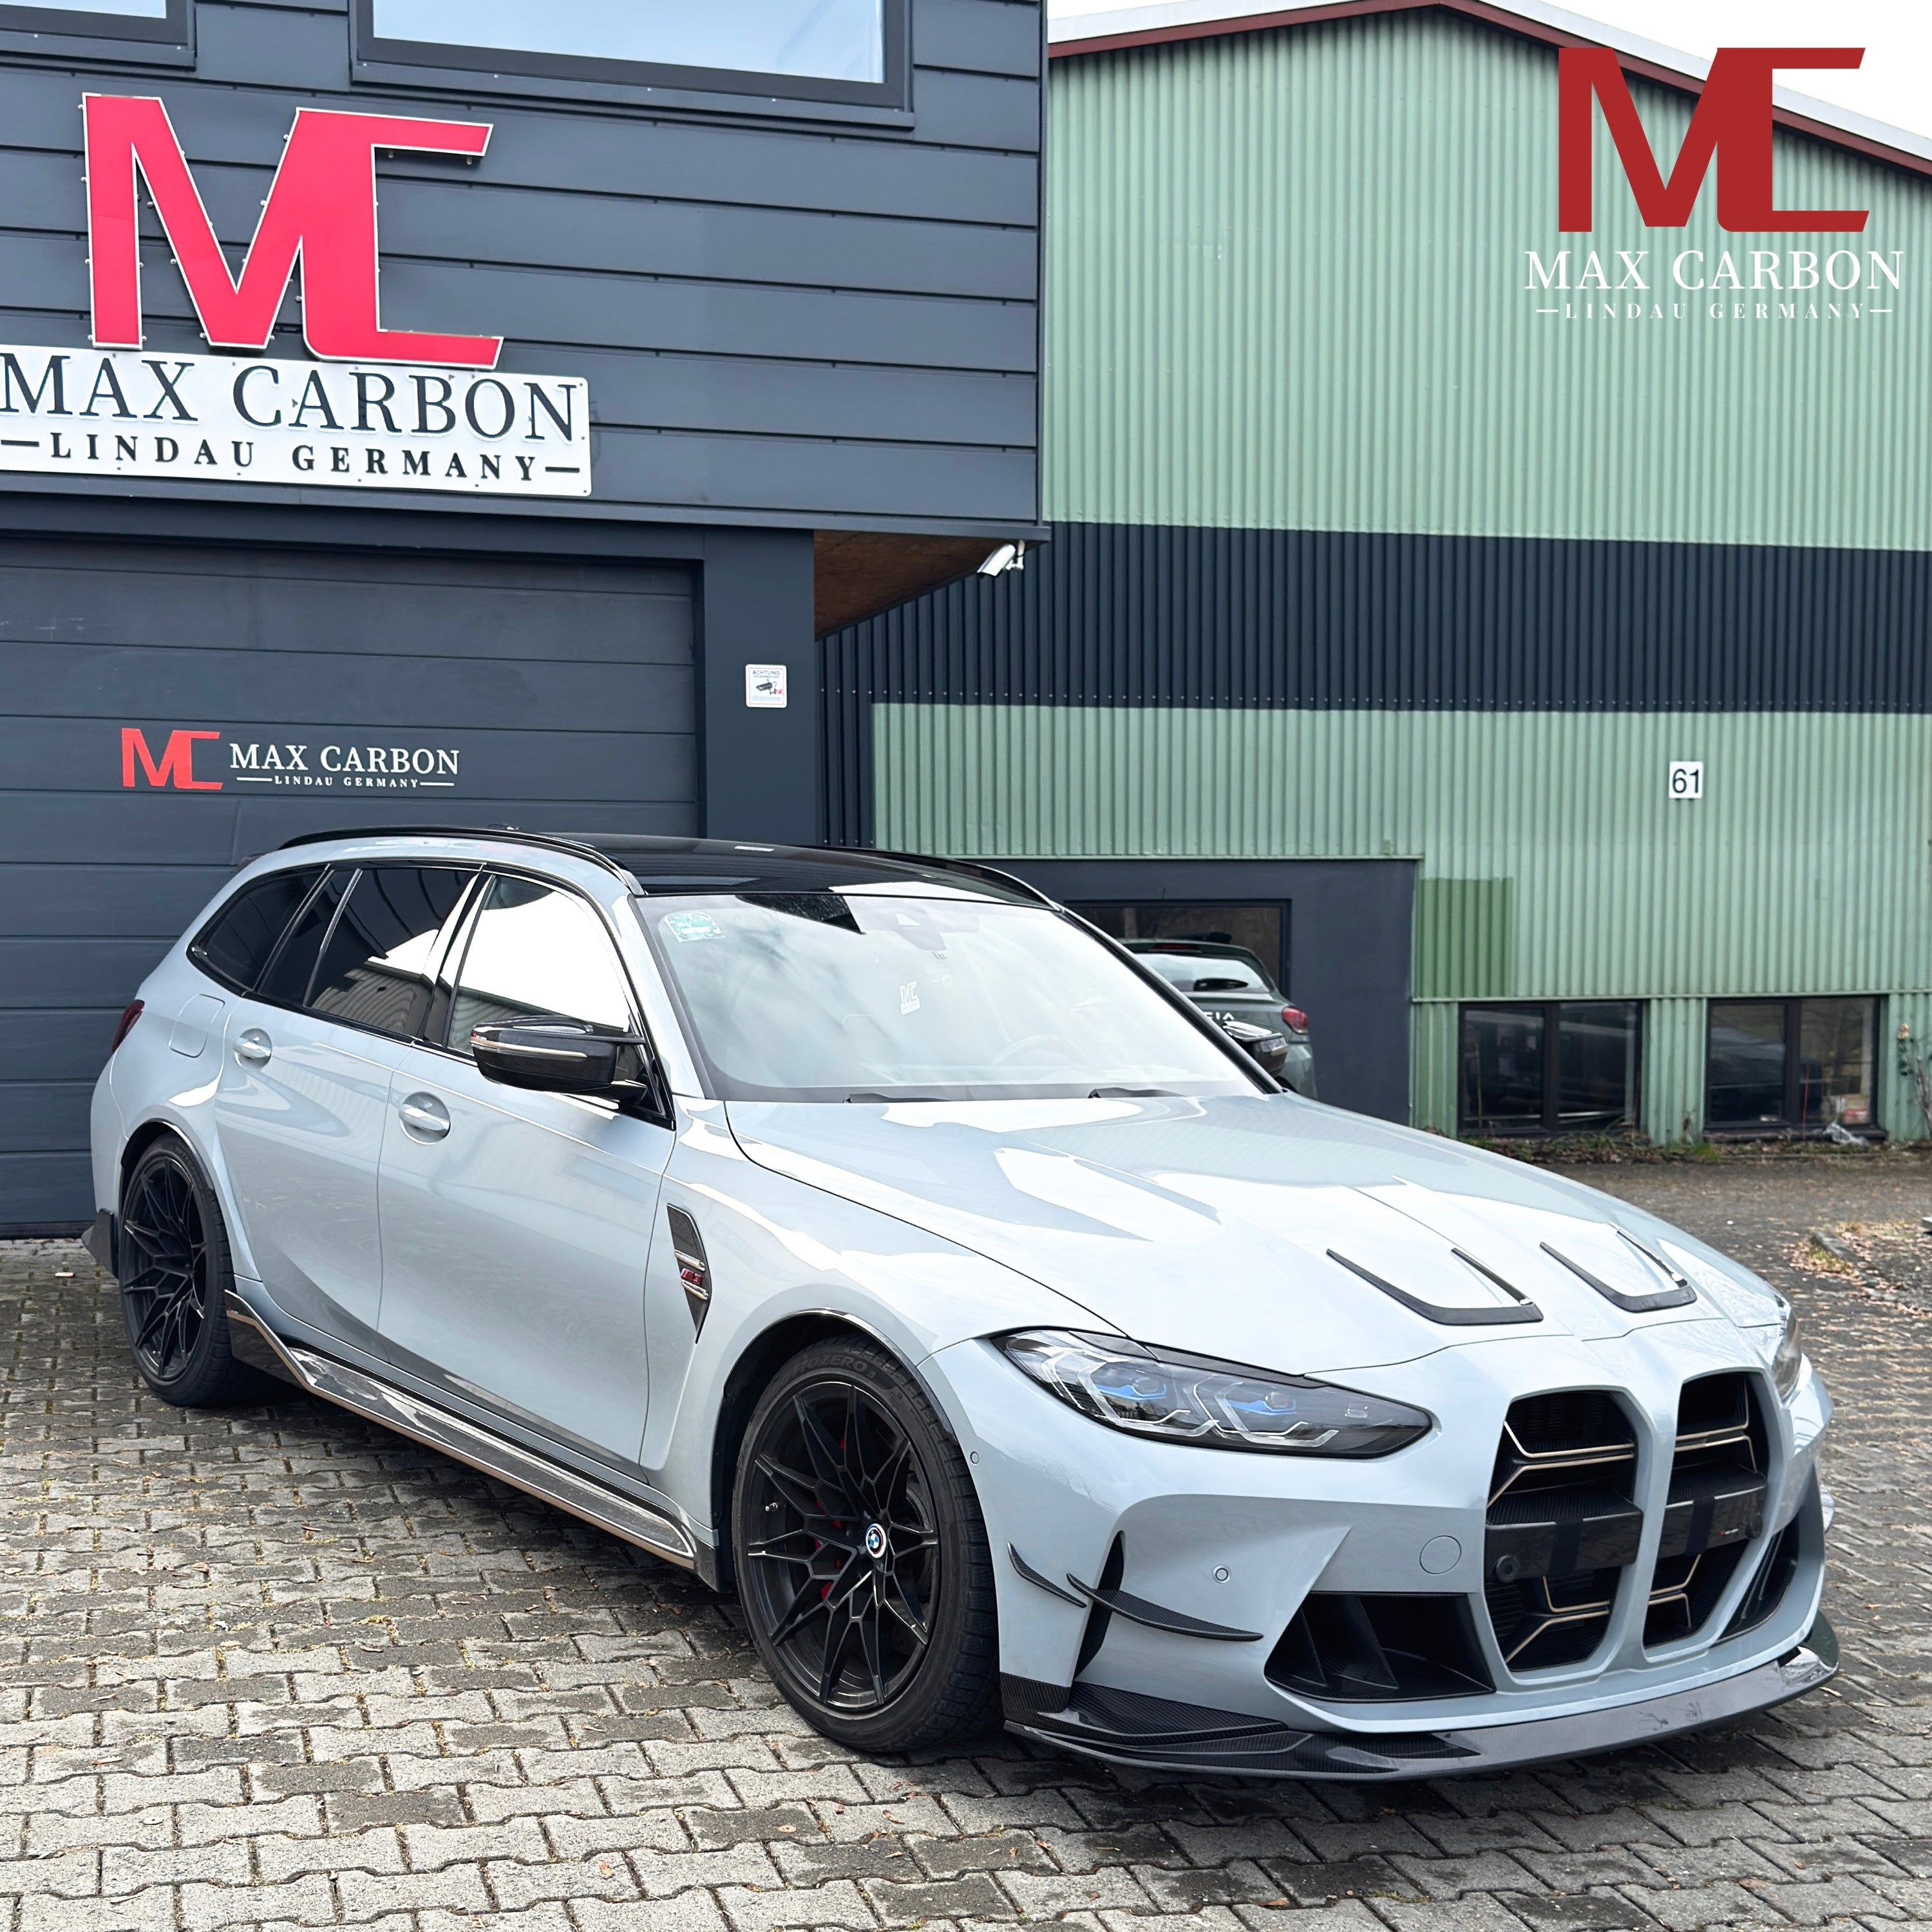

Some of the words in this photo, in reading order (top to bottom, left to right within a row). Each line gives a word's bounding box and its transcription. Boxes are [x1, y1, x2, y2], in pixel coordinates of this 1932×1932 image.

[82, 92, 504, 369] MC
[0, 352, 198, 422] MAX
[232, 365, 577, 442] CARBON
[50, 431, 254, 468] LINDAU
[292, 444, 535, 481] GERMANY
[122, 728, 223, 790] MC
[229, 743, 308, 770] MAX
[320, 745, 460, 775] CARBON
[275, 775, 334, 786] LINDAU
[343, 777, 418, 788] GERMANY
[1672, 768, 1700, 794] 61
